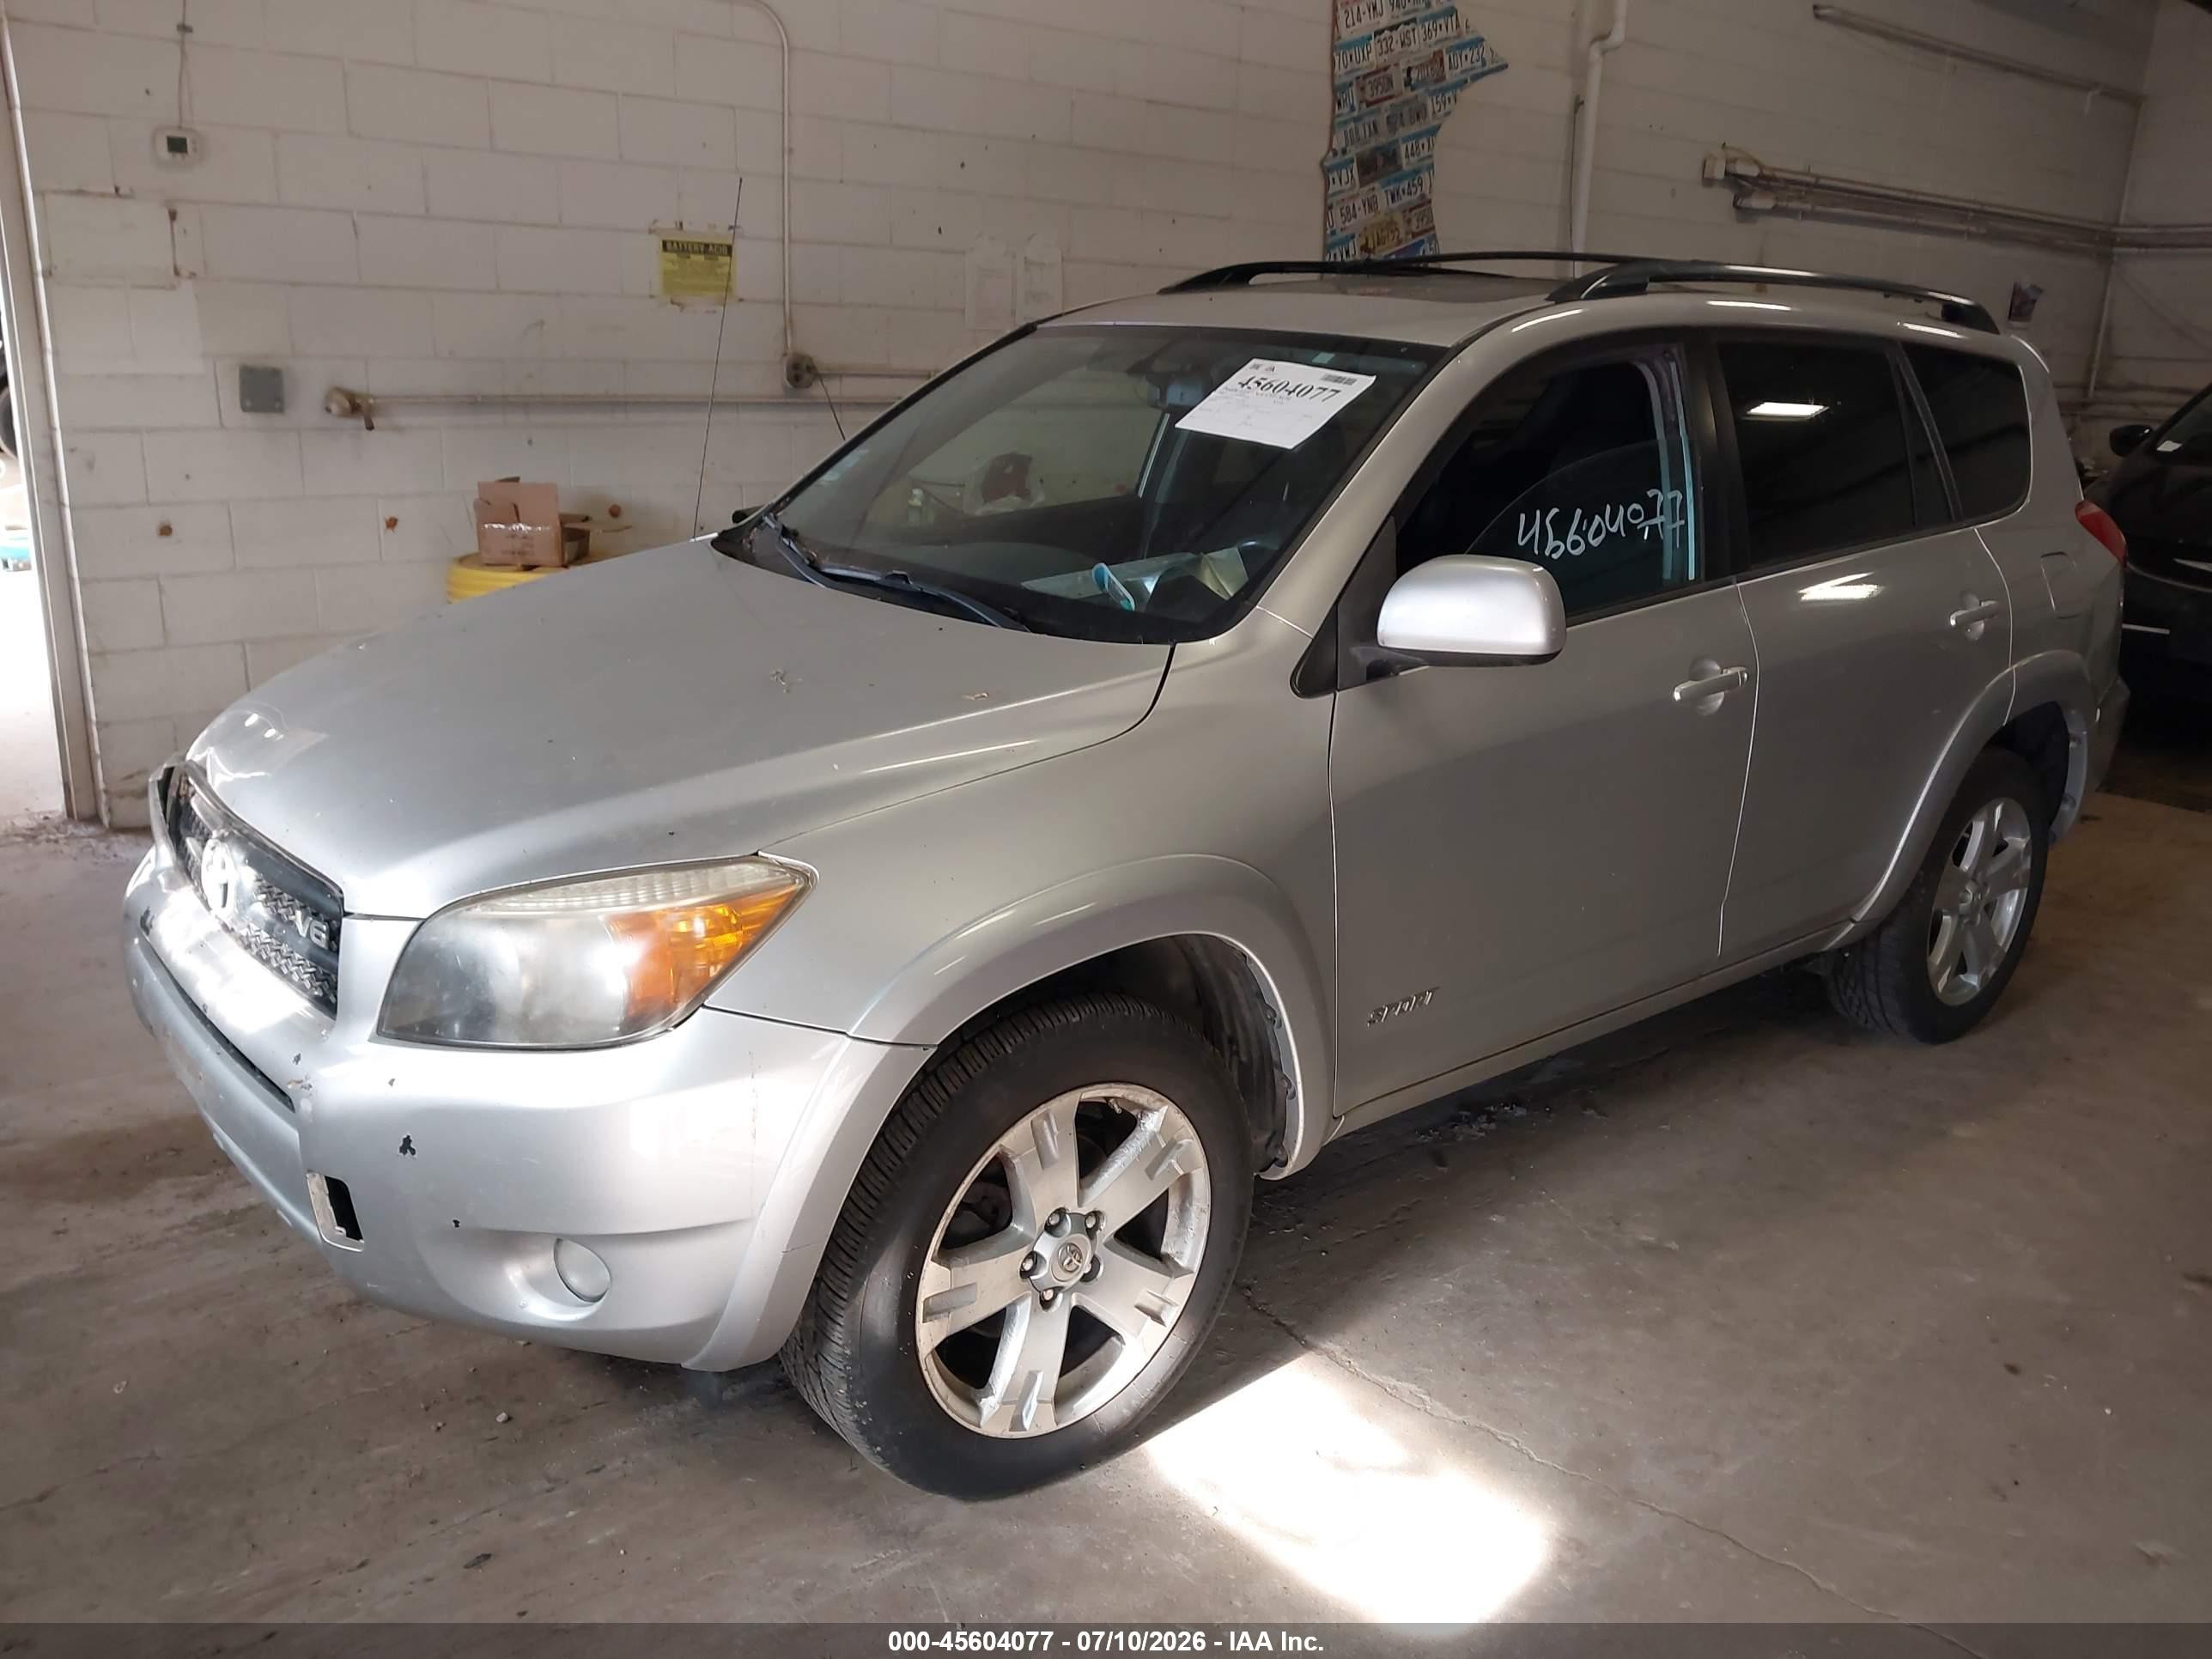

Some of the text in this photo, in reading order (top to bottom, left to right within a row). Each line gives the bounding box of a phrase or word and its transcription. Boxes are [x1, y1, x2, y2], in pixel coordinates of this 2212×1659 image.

[1238, 375, 1342, 403] 45604077
[1517, 488, 1685, 560] 45604077
[295, 909, 328, 950] V6
[1365, 987, 1439, 1029] SPORT
